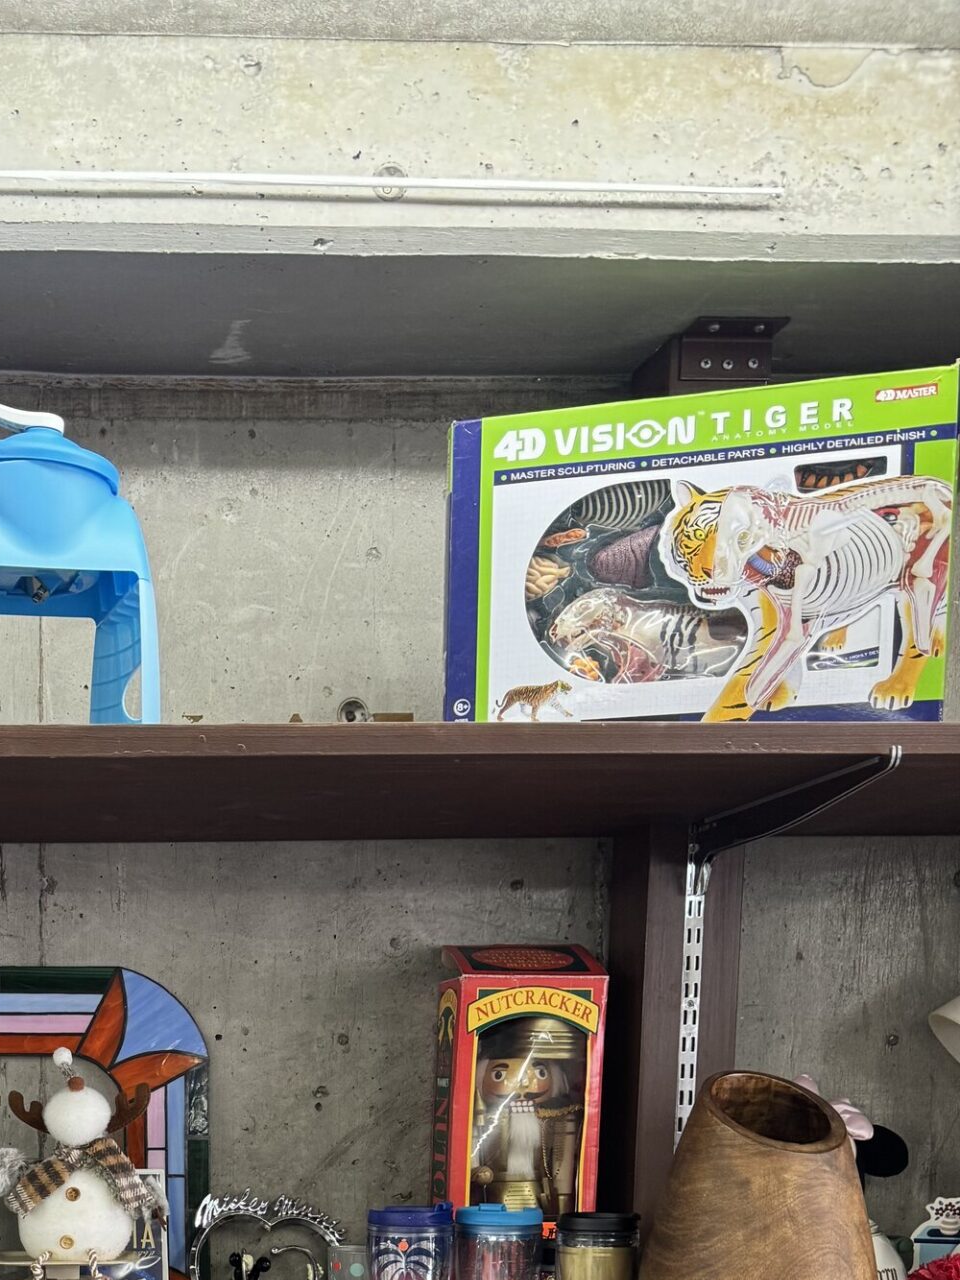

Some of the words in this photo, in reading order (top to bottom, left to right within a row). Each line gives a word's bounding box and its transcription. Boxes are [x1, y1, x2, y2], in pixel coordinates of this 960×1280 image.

[895, 386, 937, 400] MASTER
[493, 428, 546, 462] 4D
[554, 415, 696, 456] VISION
[711, 398, 854, 434] TIGER
[711, 428, 787, 442] ANATOMY
[799, 420, 855, 432] MODEL
[782, 440, 826, 454] HIGHLY
[826, 434, 884, 449] DETAILED
[888, 430, 926, 442] FINISH
[652, 452, 726, 468] DETACHABLE
[727, 447, 766, 459] PARTS
[510, 468, 556, 481] MASTER
[557, 461, 636, 476] SCULPTURING
[475, 989, 593, 1024] NUTCRACKER
